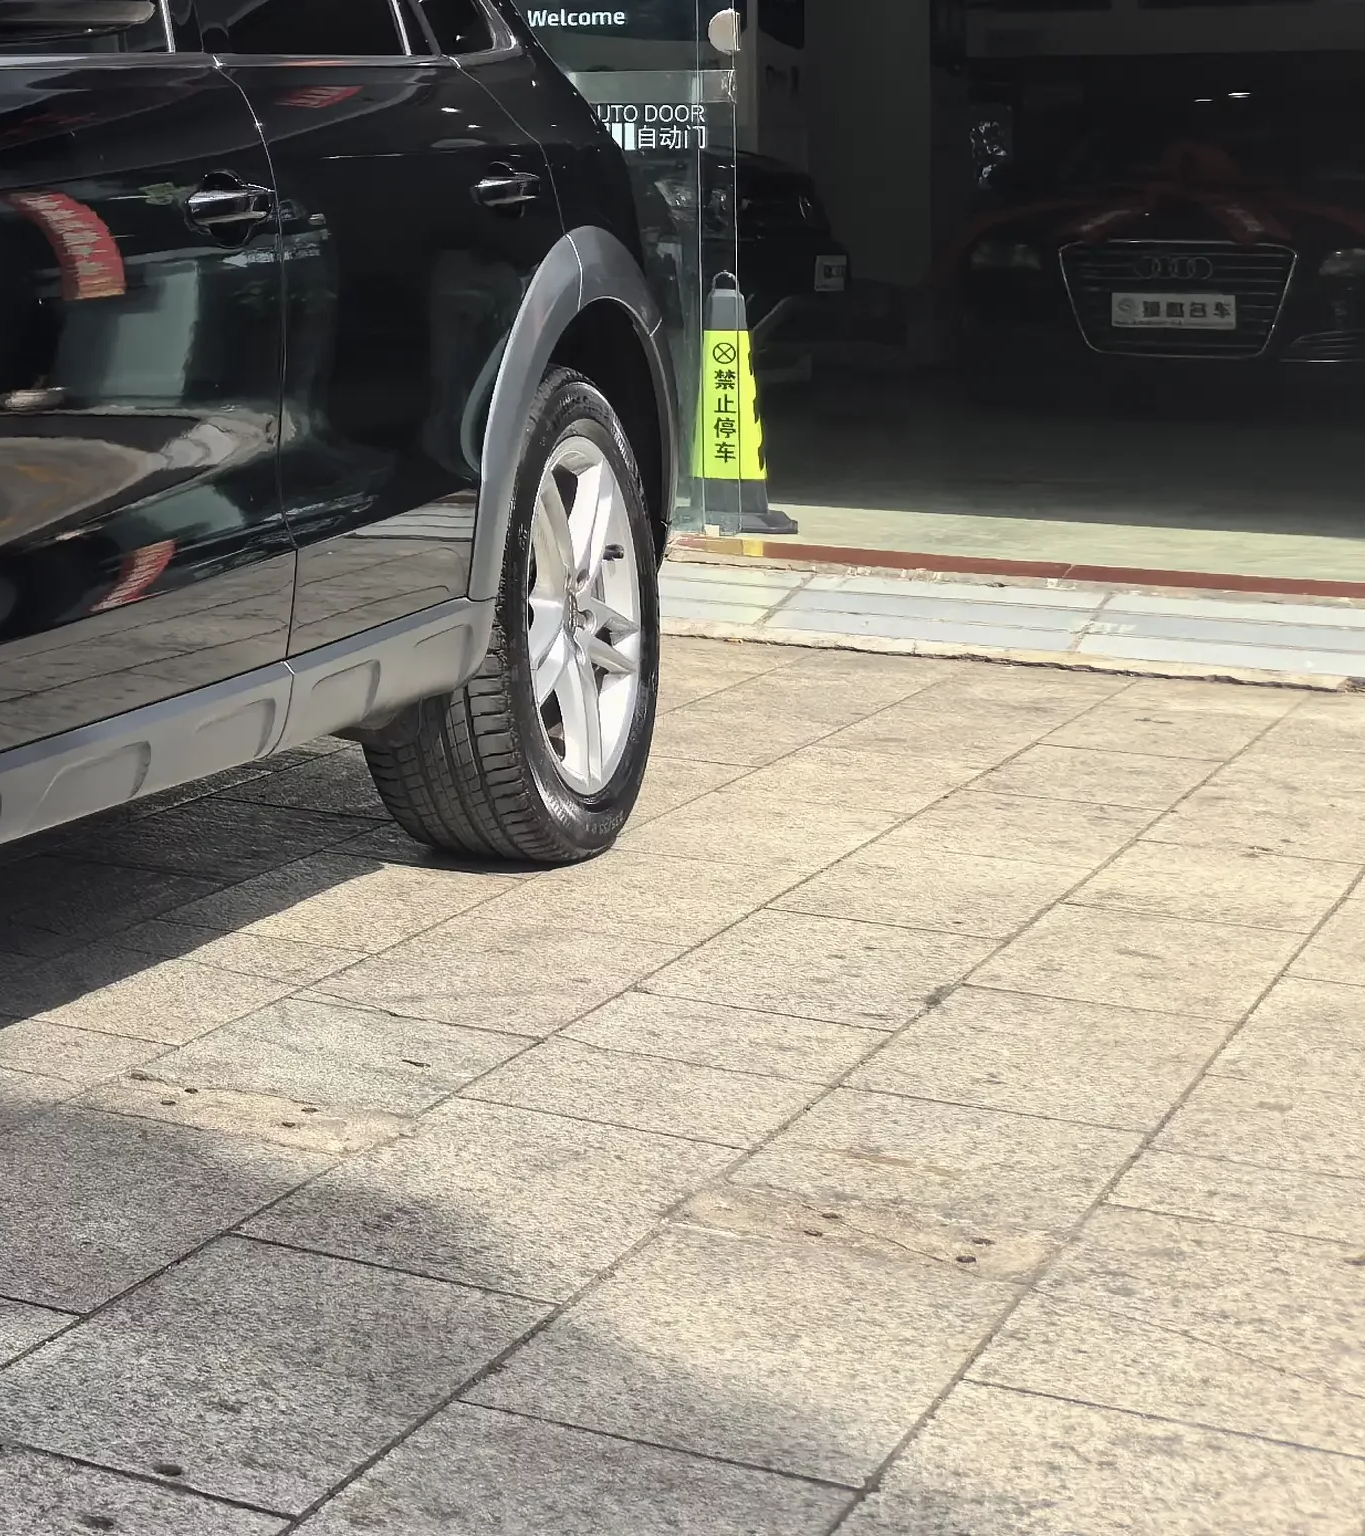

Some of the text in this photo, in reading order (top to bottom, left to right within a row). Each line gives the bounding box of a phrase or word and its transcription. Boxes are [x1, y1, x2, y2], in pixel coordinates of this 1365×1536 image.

[526, 9, 626, 28] Welcome
[595, 104, 706, 124] UTO DOOR
[637, 124, 707, 150] 自动门
[713, 368, 737, 464] 禁止停车
